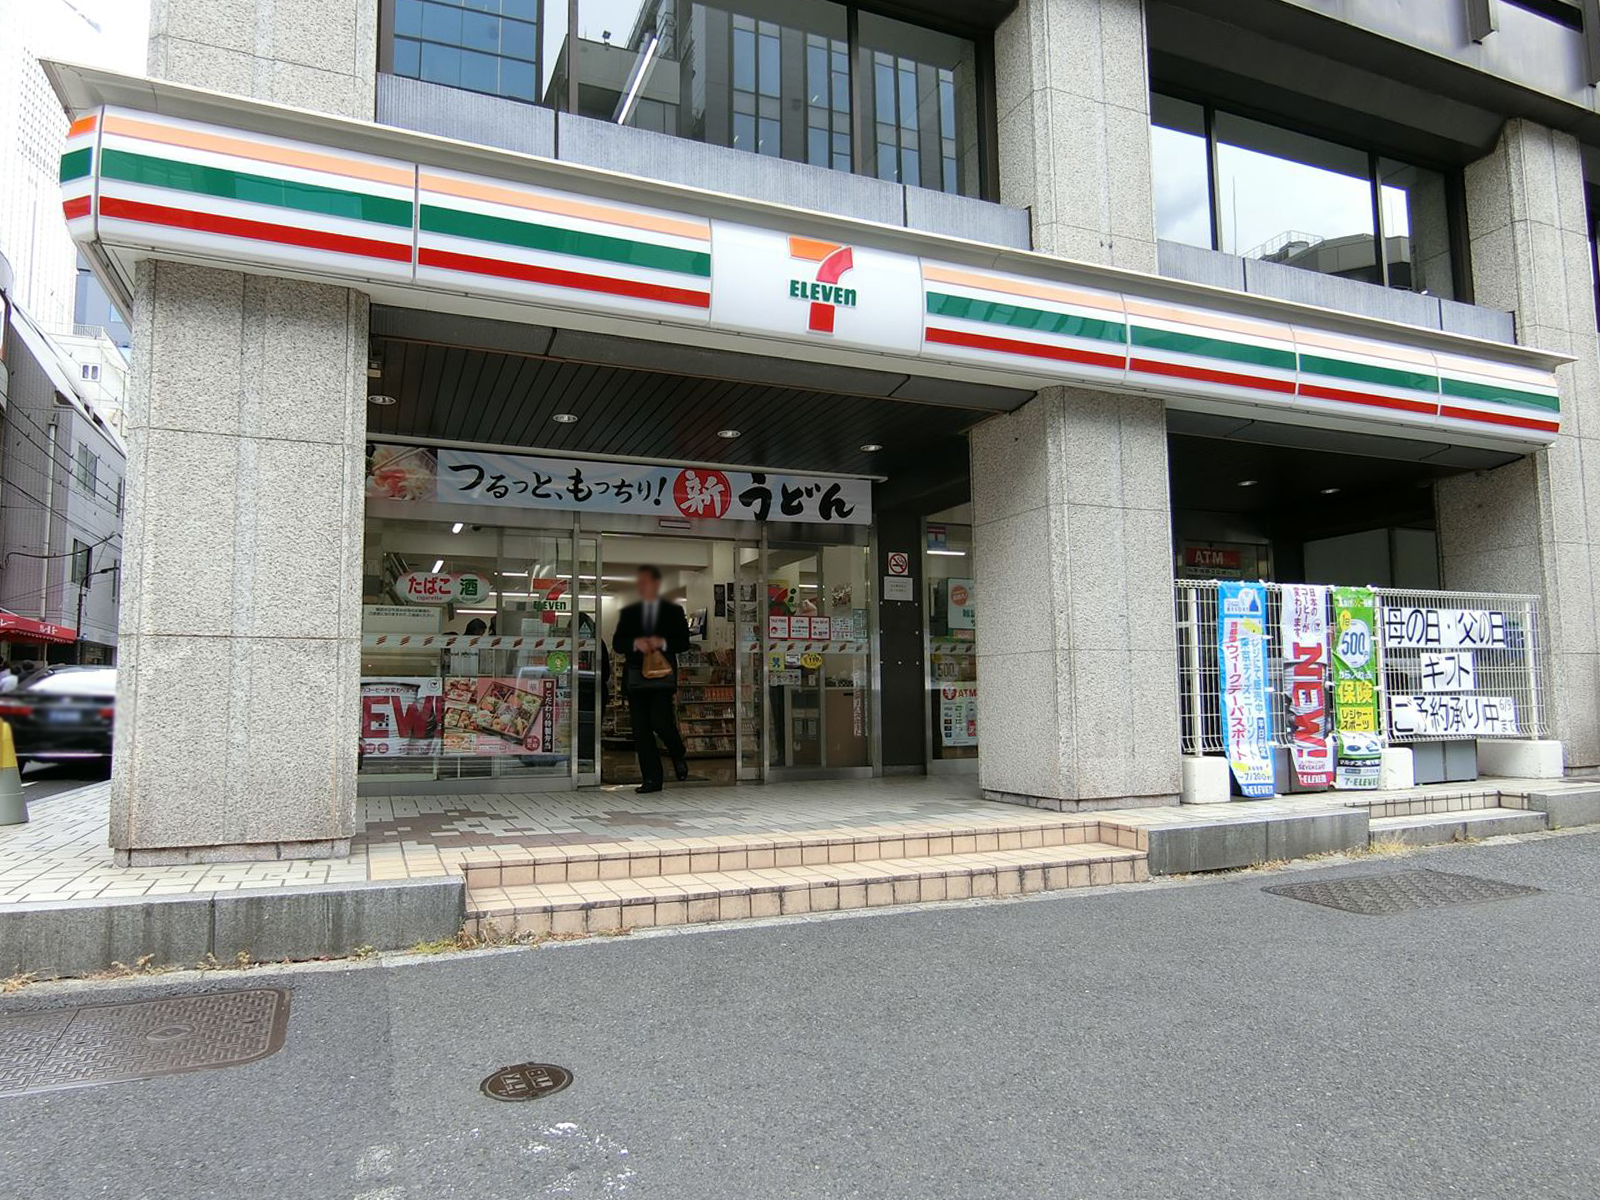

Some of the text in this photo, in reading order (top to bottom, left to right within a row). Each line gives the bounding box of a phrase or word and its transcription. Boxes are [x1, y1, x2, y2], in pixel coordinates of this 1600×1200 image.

[448, 464, 856, 521] つるっと、もっちり！ 新 うどん
[1194, 550, 1224, 565] ATM
[407, 576, 478, 596] たばこ 酒
[1386, 608, 1505, 646] 母の日・父の日
[1423, 654, 1470, 690] ギフト
[1292, 642, 1328, 758] NEW!
[1338, 681, 1374, 703] 保険
[1341, 720, 1370, 730] スポーツ
